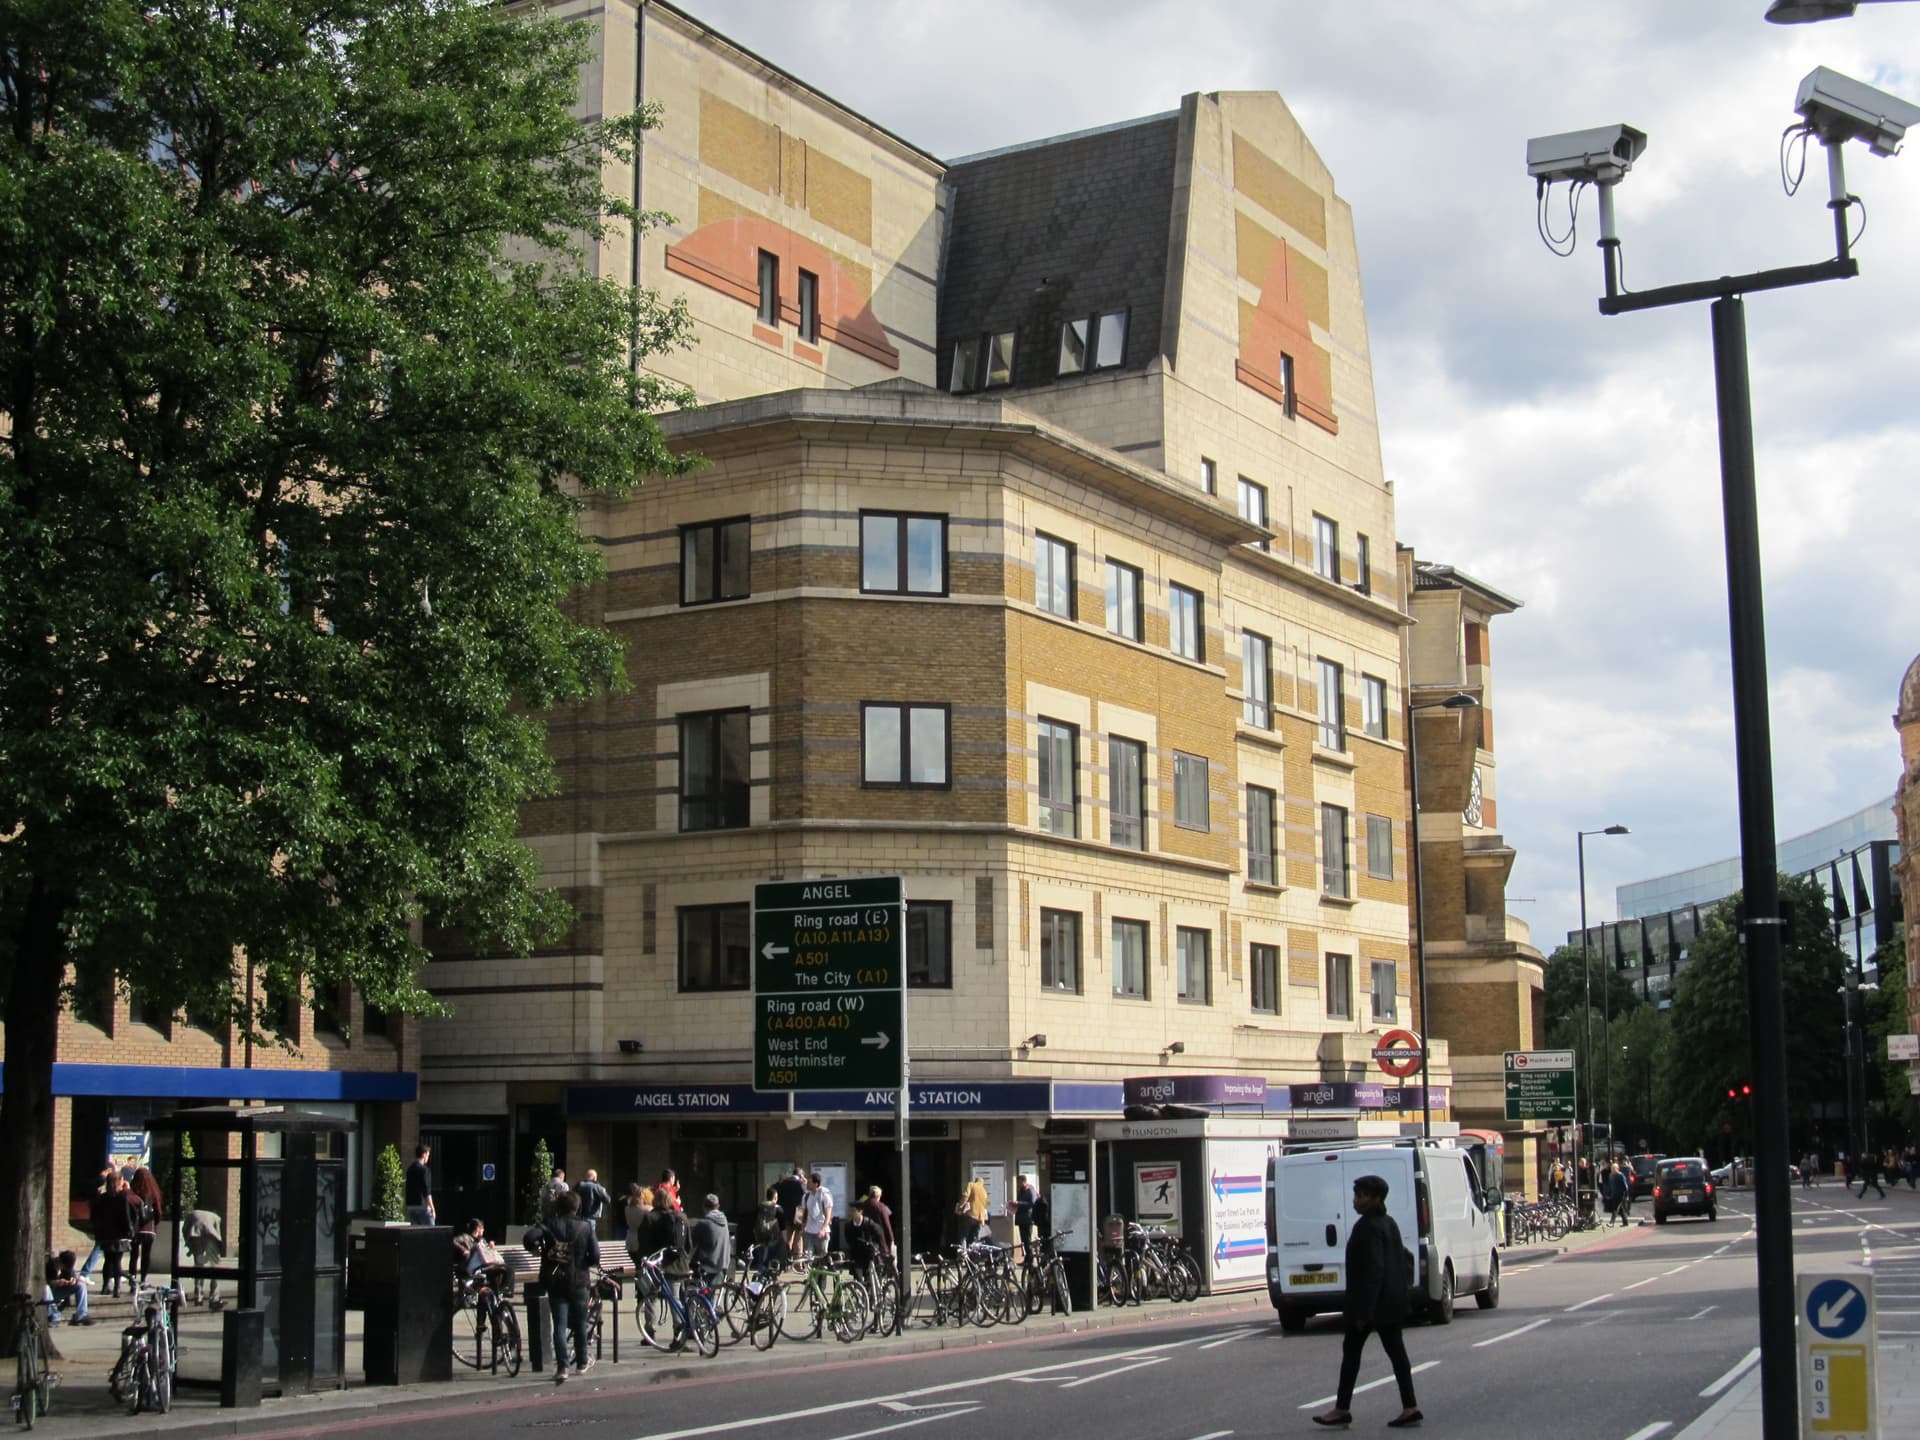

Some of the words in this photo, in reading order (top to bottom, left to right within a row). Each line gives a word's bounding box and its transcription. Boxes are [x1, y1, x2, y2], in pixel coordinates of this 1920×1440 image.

[802, 886, 851, 899] ANGEL
[794, 914, 822, 929] Ring
[828, 912, 858, 926] road
[865, 910, 889, 926] (E)
[795, 952, 829, 965] A501
[795, 972, 818, 985] The
[824, 971, 851, 986] City
[856, 969, 889, 984] (A1)
[767, 1000, 795, 1014] Ring
[801, 998, 830, 1011] road
[837, 996, 865, 1012] (W)
[768, 1038, 799, 1050] West
[804, 1037, 828, 1049] End
[768, 1055, 846, 1067] Westminster
[768, 1072, 798, 1083] A501
[1140, 1081, 1175, 1100] angel
[1303, 1088, 1334, 1104] angel
[634, 1093, 675, 1106] ANGEL
[678, 1093, 730, 1106] STATION
[919, 1091, 981, 1104] STATION
[1132, 1127, 1178, 1137] ISLINGTON
